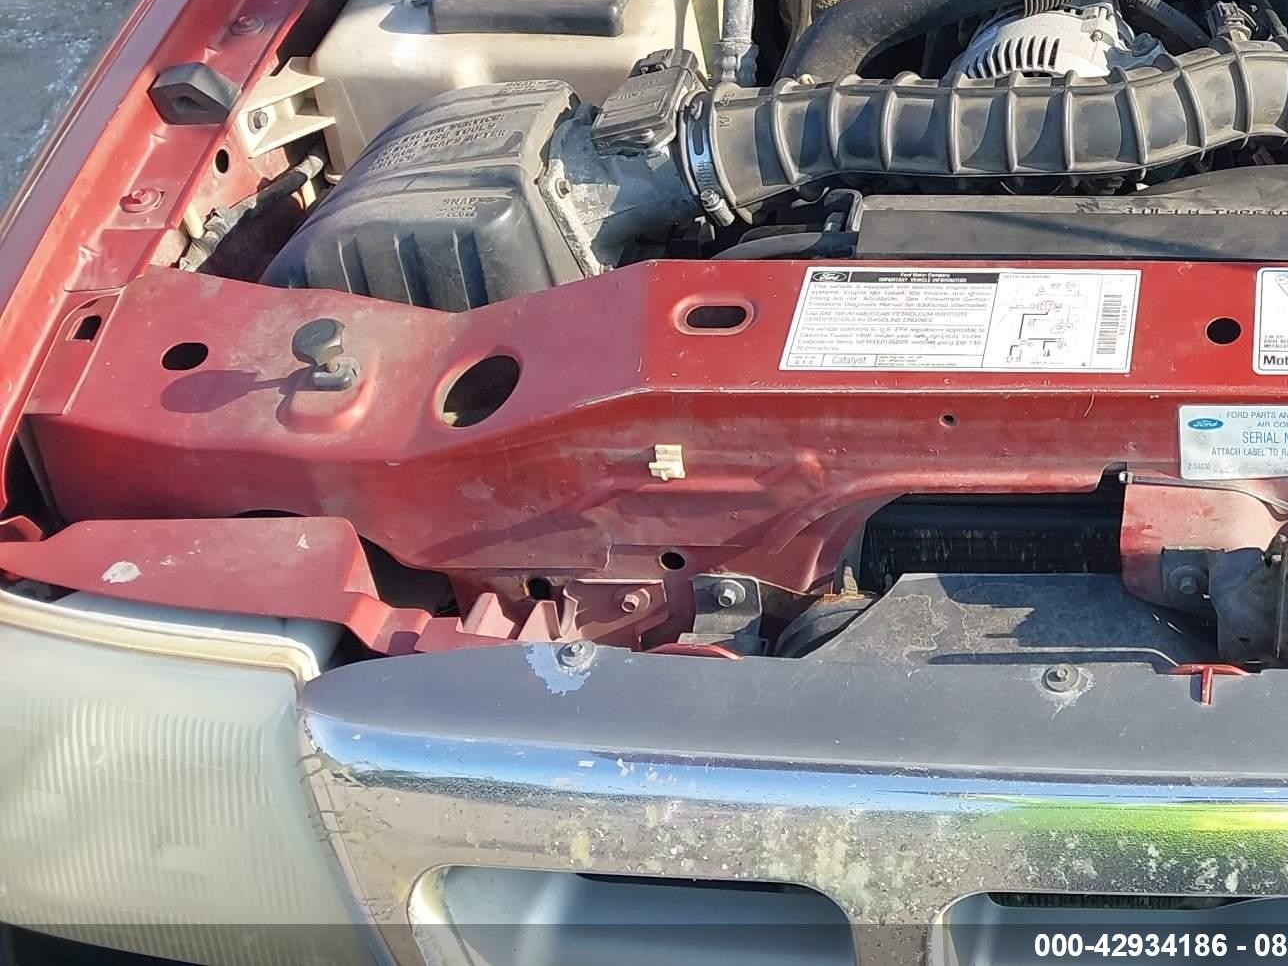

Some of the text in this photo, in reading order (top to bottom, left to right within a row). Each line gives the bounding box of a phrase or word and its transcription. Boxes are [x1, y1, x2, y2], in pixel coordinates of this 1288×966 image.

[832, 356, 866, 365] Catalyst
[1192, 420, 1218, 428] Ford
[1242, 432, 1280, 444] SERIAL
[1211, 448, 1240, 456] ATTACH
[1243, 448, 1265, 456] LABEL
[1268, 448, 1278, 456] TO
